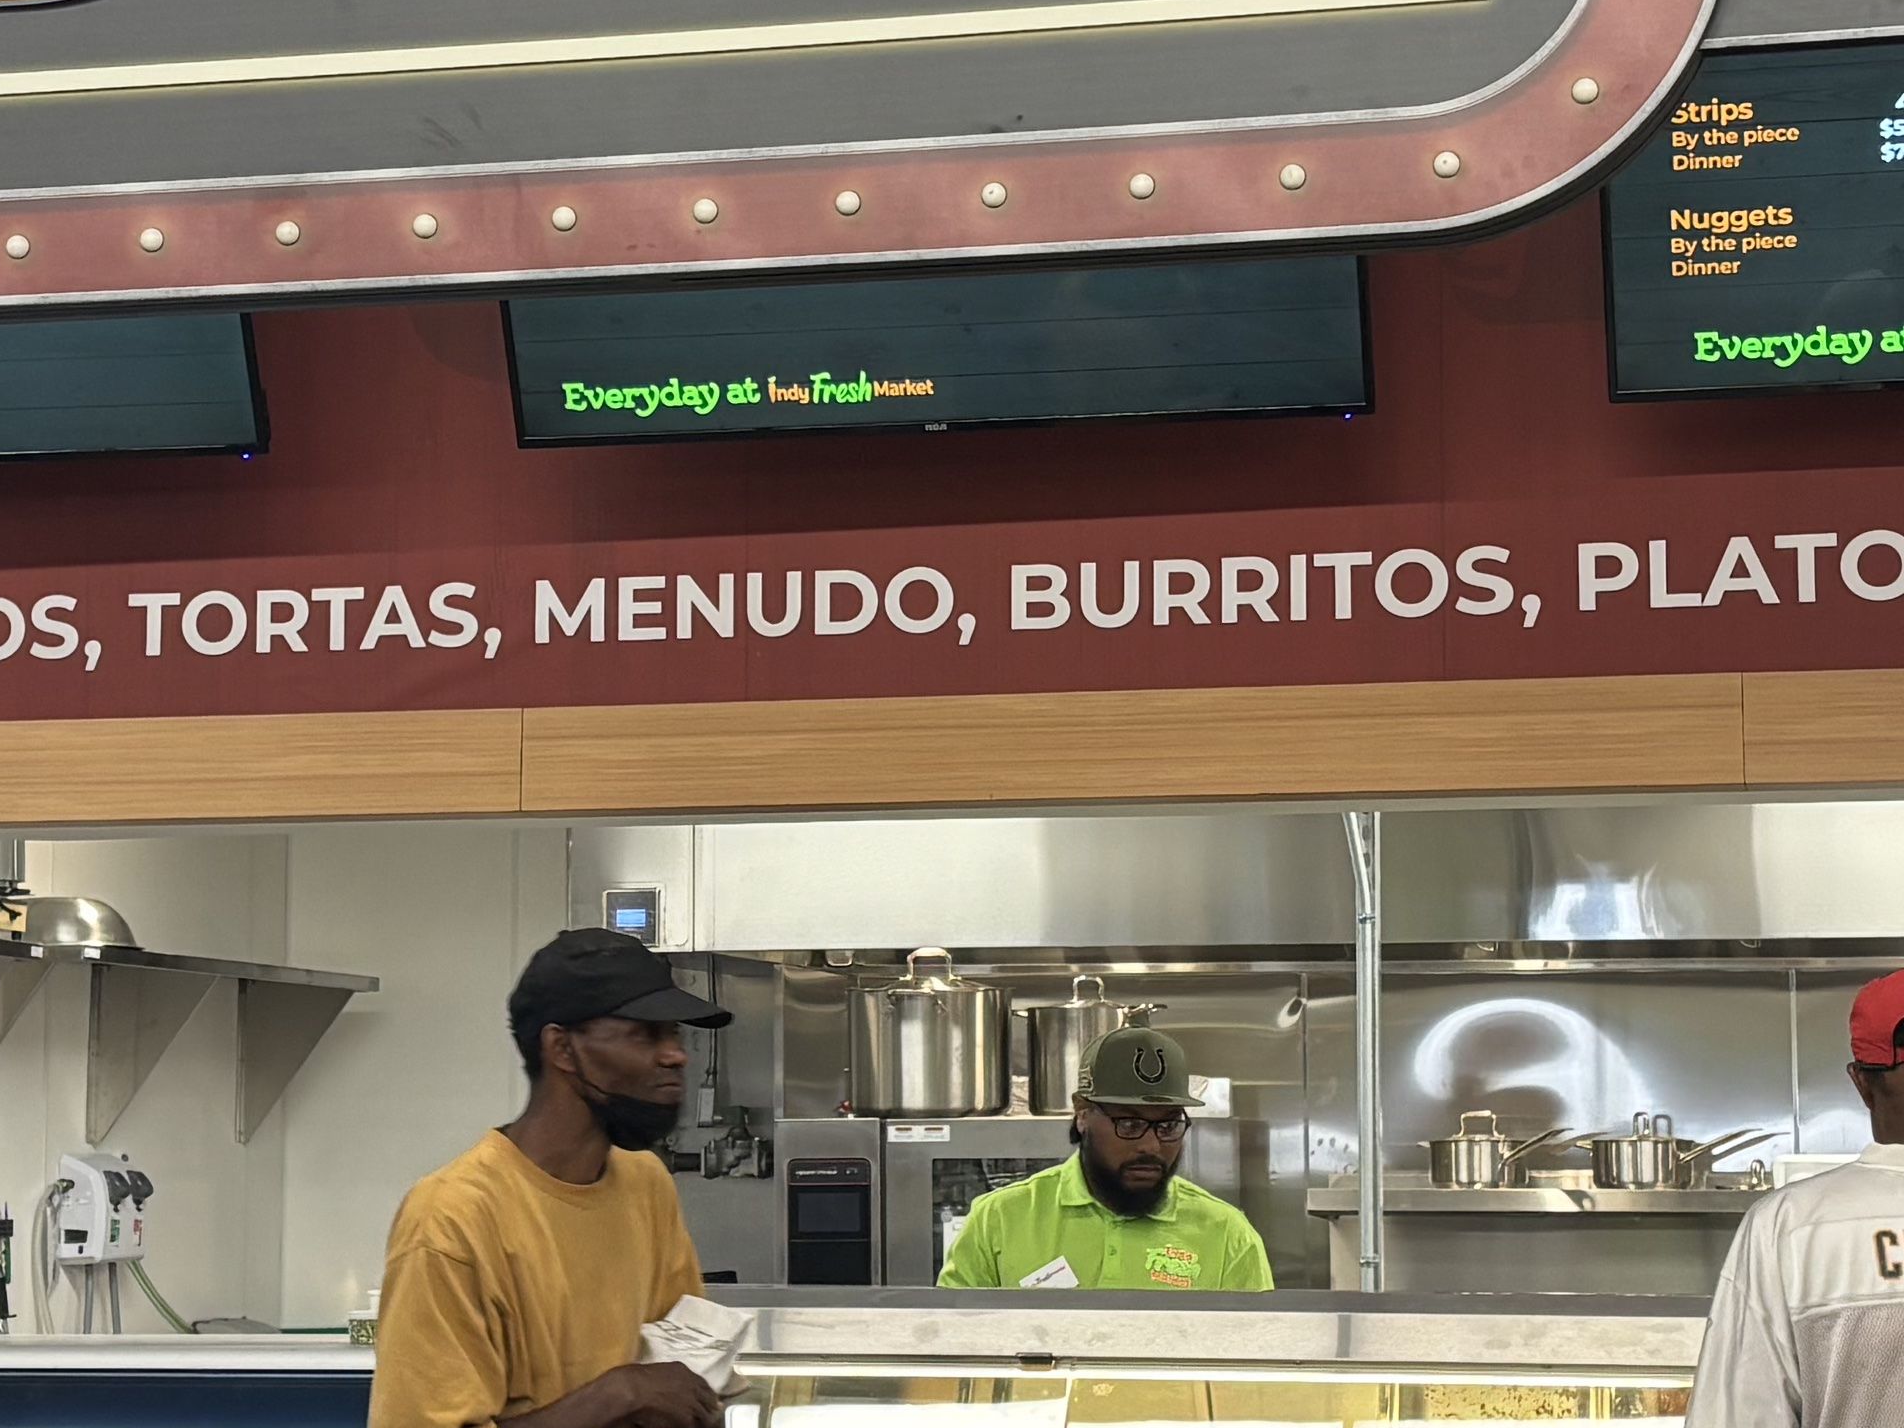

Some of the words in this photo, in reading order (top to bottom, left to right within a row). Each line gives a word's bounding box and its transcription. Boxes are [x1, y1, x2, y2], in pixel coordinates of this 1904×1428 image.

[1672, 98, 1753, 126] Strips
[1672, 129, 1699, 150] By
[1706, 127, 1743, 145] the
[1749, 126, 1799, 146] piece
[1673, 151, 1742, 172] Dinner
[1670, 205, 1794, 232] Nuggets
[1672, 237, 1699, 257] By
[1706, 235, 1742, 253] the
[1749, 232, 1797, 253] piece
[1671, 257, 1741, 278] Dinner
[1694, 325, 1872, 366] Everyday
[562, 378, 719, 417] Everyday
[726, 377, 760, 405] at
[810, 371, 872, 404] Fresh
[873, 378, 934, 397] Market
[128, 581, 502, 661] TORTAS,
[534, 564, 977, 648] MENUDO,
[1007, 546, 1543, 632] BURRITOS,
